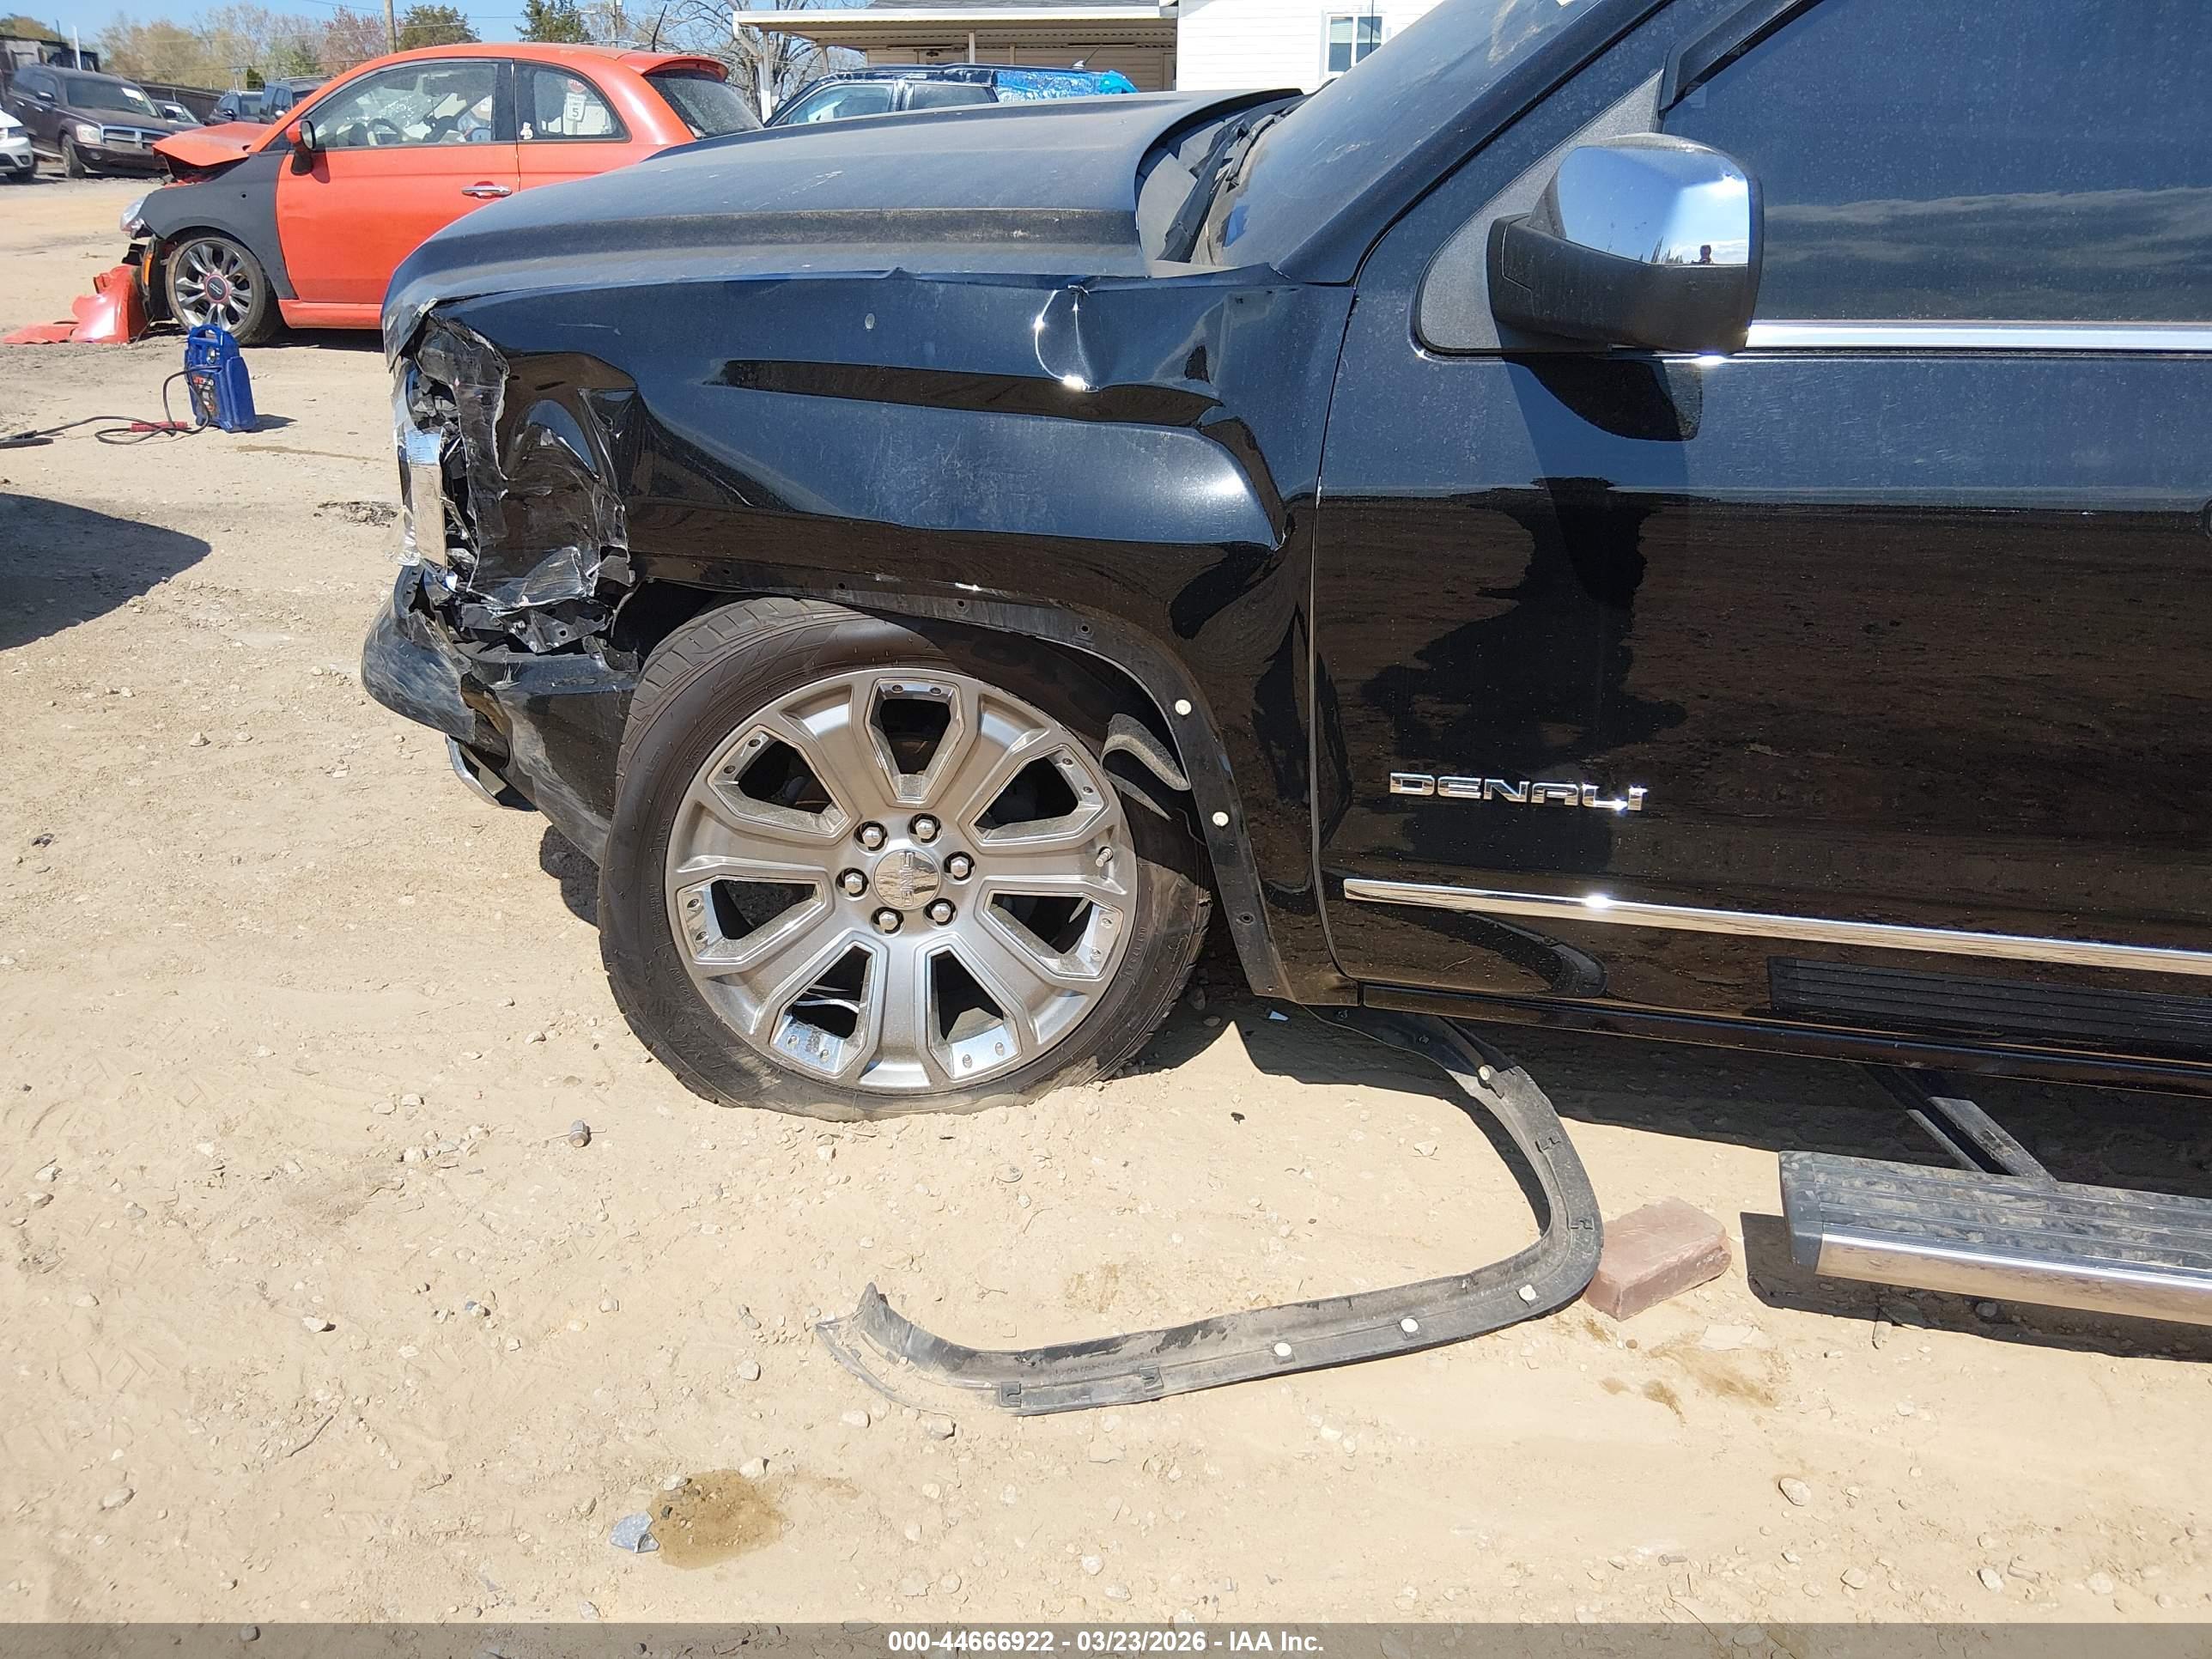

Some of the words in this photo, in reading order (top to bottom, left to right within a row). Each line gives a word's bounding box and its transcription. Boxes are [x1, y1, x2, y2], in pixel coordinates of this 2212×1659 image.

[572, 107, 580, 118] 5
[1389, 771, 1649, 811] DENALI
[899, 851, 915, 908] GMC
